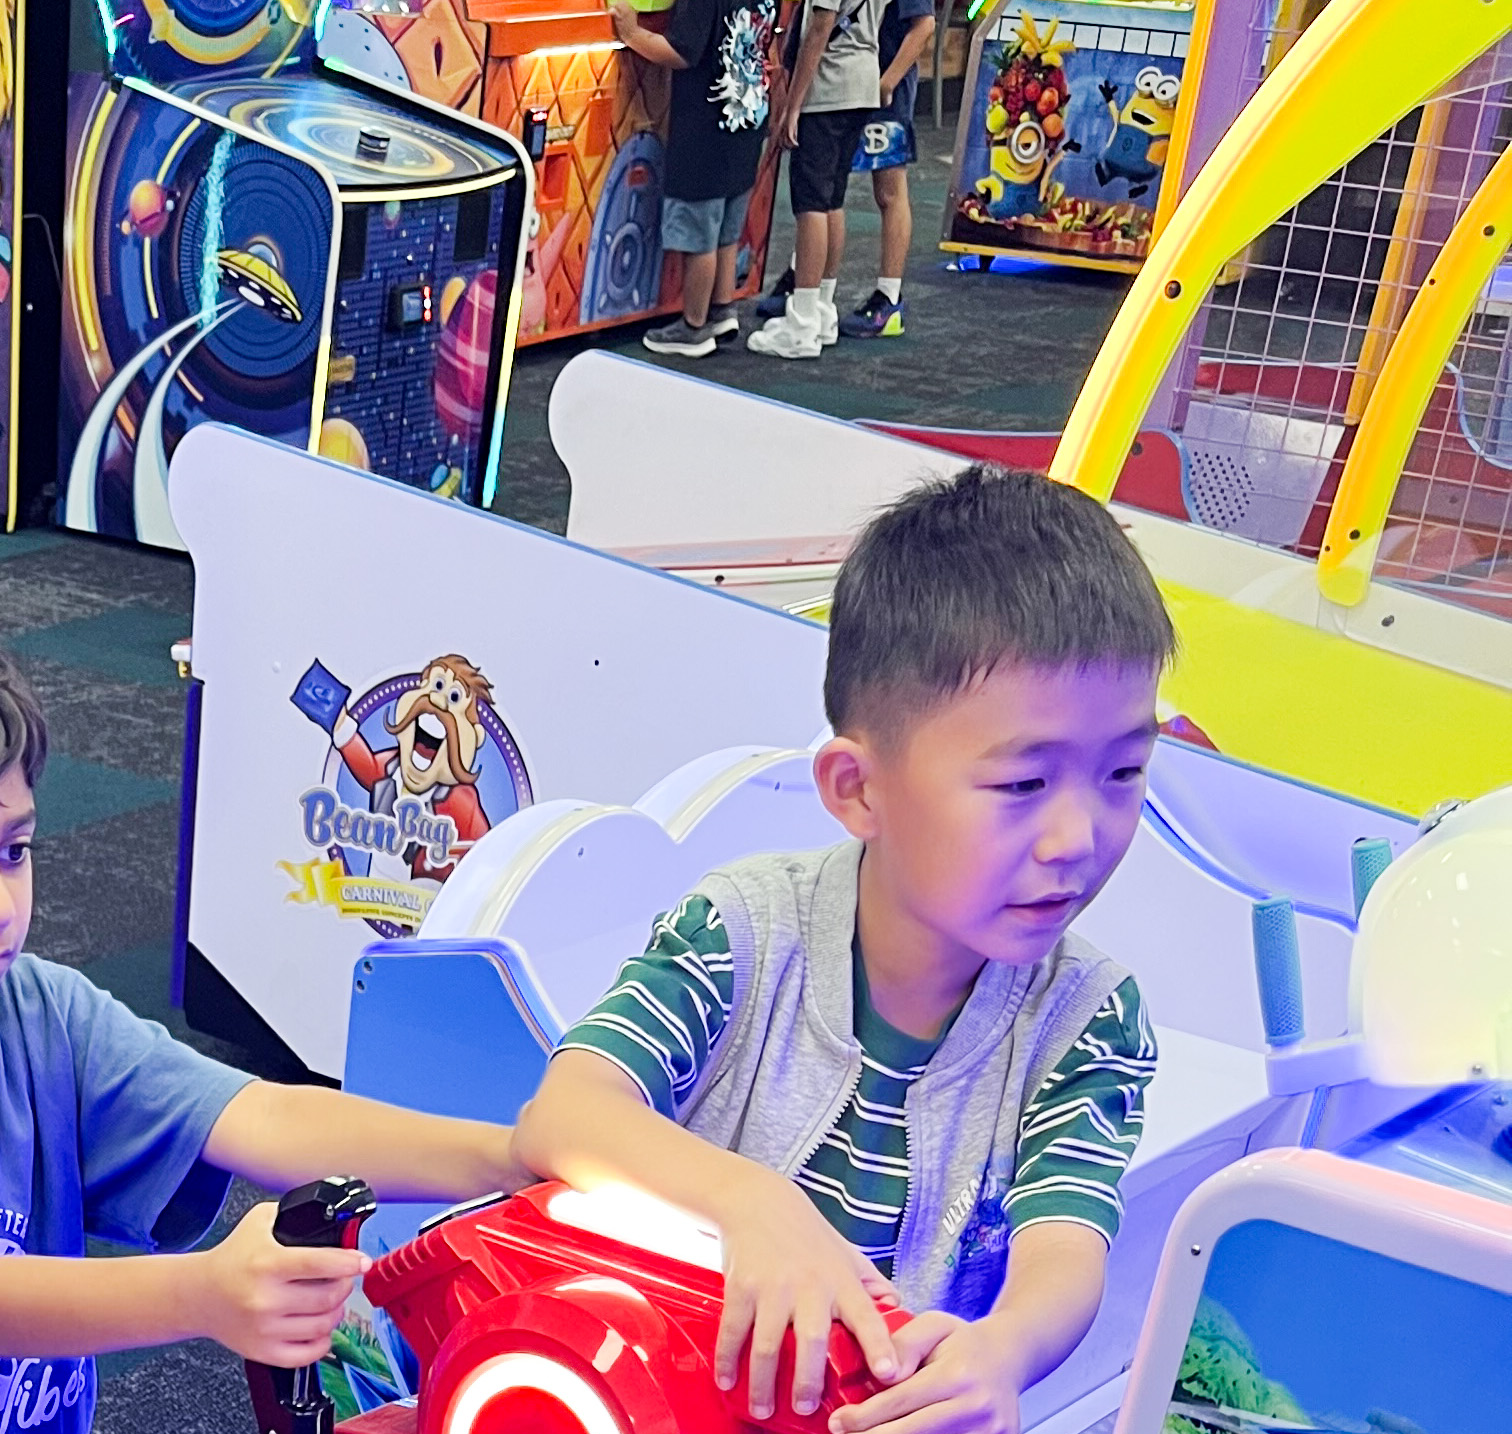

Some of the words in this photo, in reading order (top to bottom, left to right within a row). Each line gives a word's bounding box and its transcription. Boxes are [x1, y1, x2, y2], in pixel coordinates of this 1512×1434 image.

[299, 787, 404, 857] Bean
[393, 798, 458, 863] Bag
[341, 884, 422, 912] CARNIVAL
